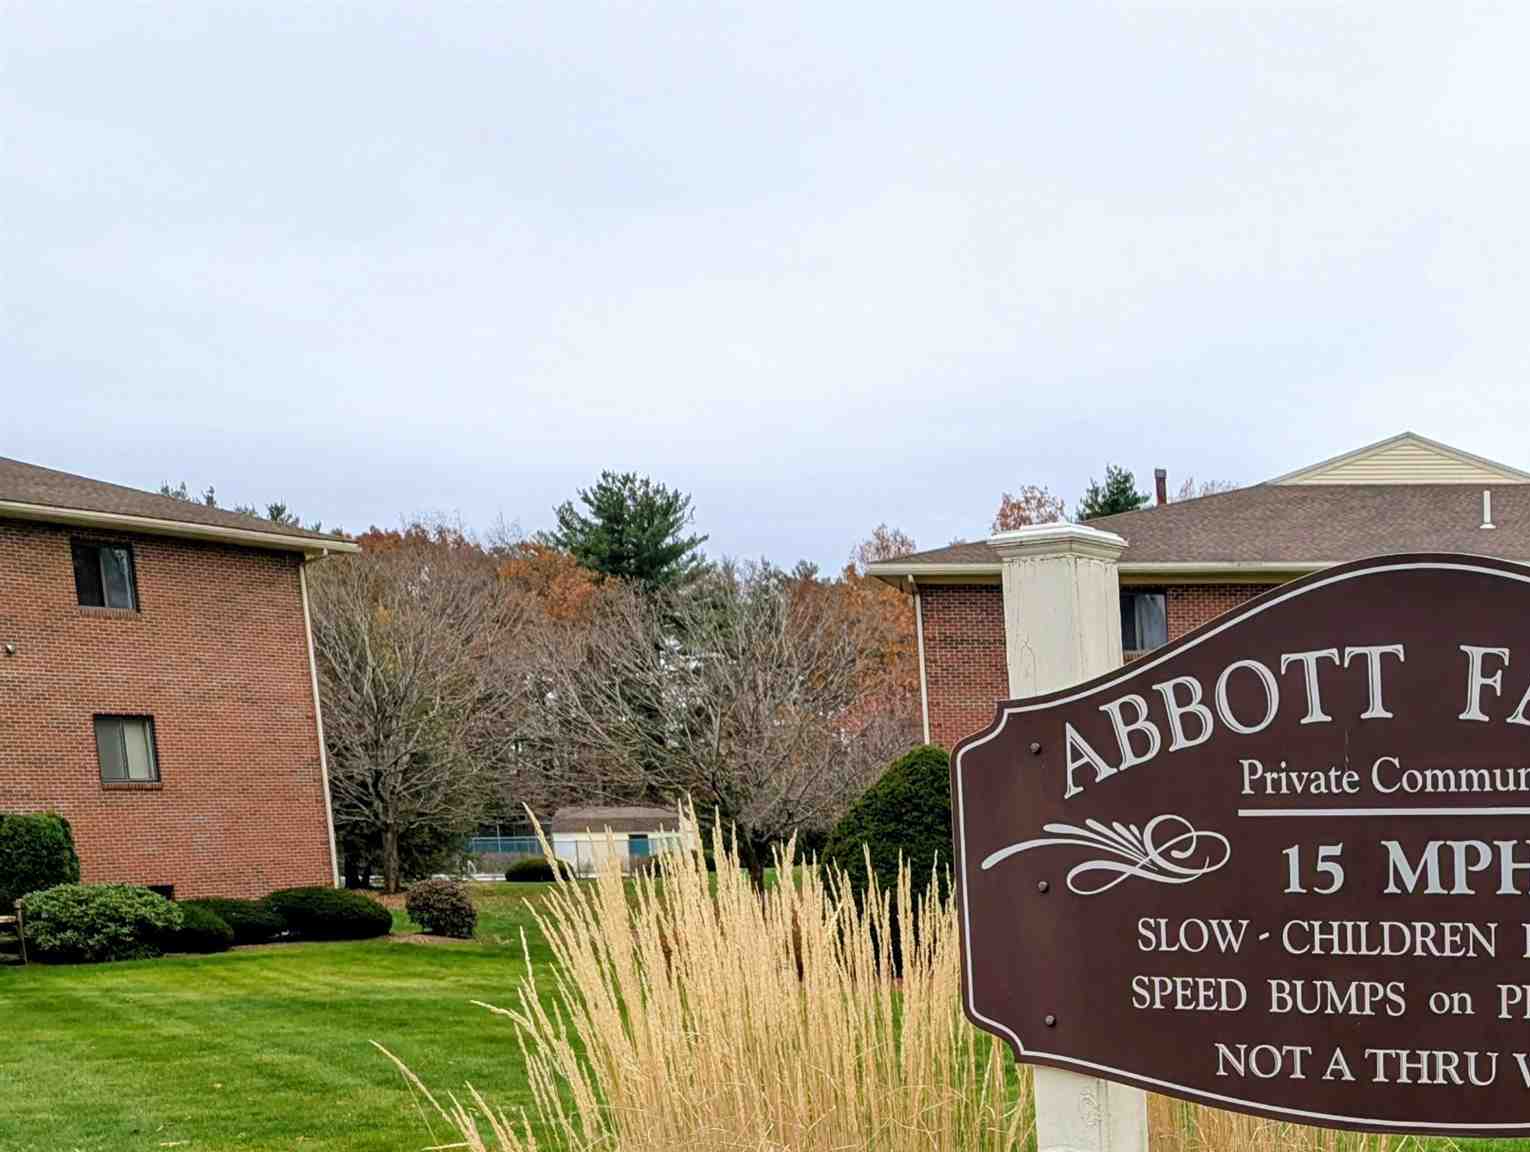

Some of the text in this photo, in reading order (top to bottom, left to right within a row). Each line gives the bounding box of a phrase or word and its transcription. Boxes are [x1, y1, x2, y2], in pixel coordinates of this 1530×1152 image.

[1063, 643, 1405, 800] ABBOTT
[1239, 759, 1360, 795] Private
[1282, 842, 1344, 894] 15
[1137, 917, 1250, 953] SLOW
[1282, 919, 1498, 957] CHILDREN
[1132, 975, 1247, 1012] SPEED
[1267, 979, 1406, 1017] BUMPS
[1429, 991, 1475, 1015] on
[1214, 1043, 1313, 1079] NOT
[1322, 1047, 1356, 1081] A
[1364, 1048, 1499, 1086] THRU
